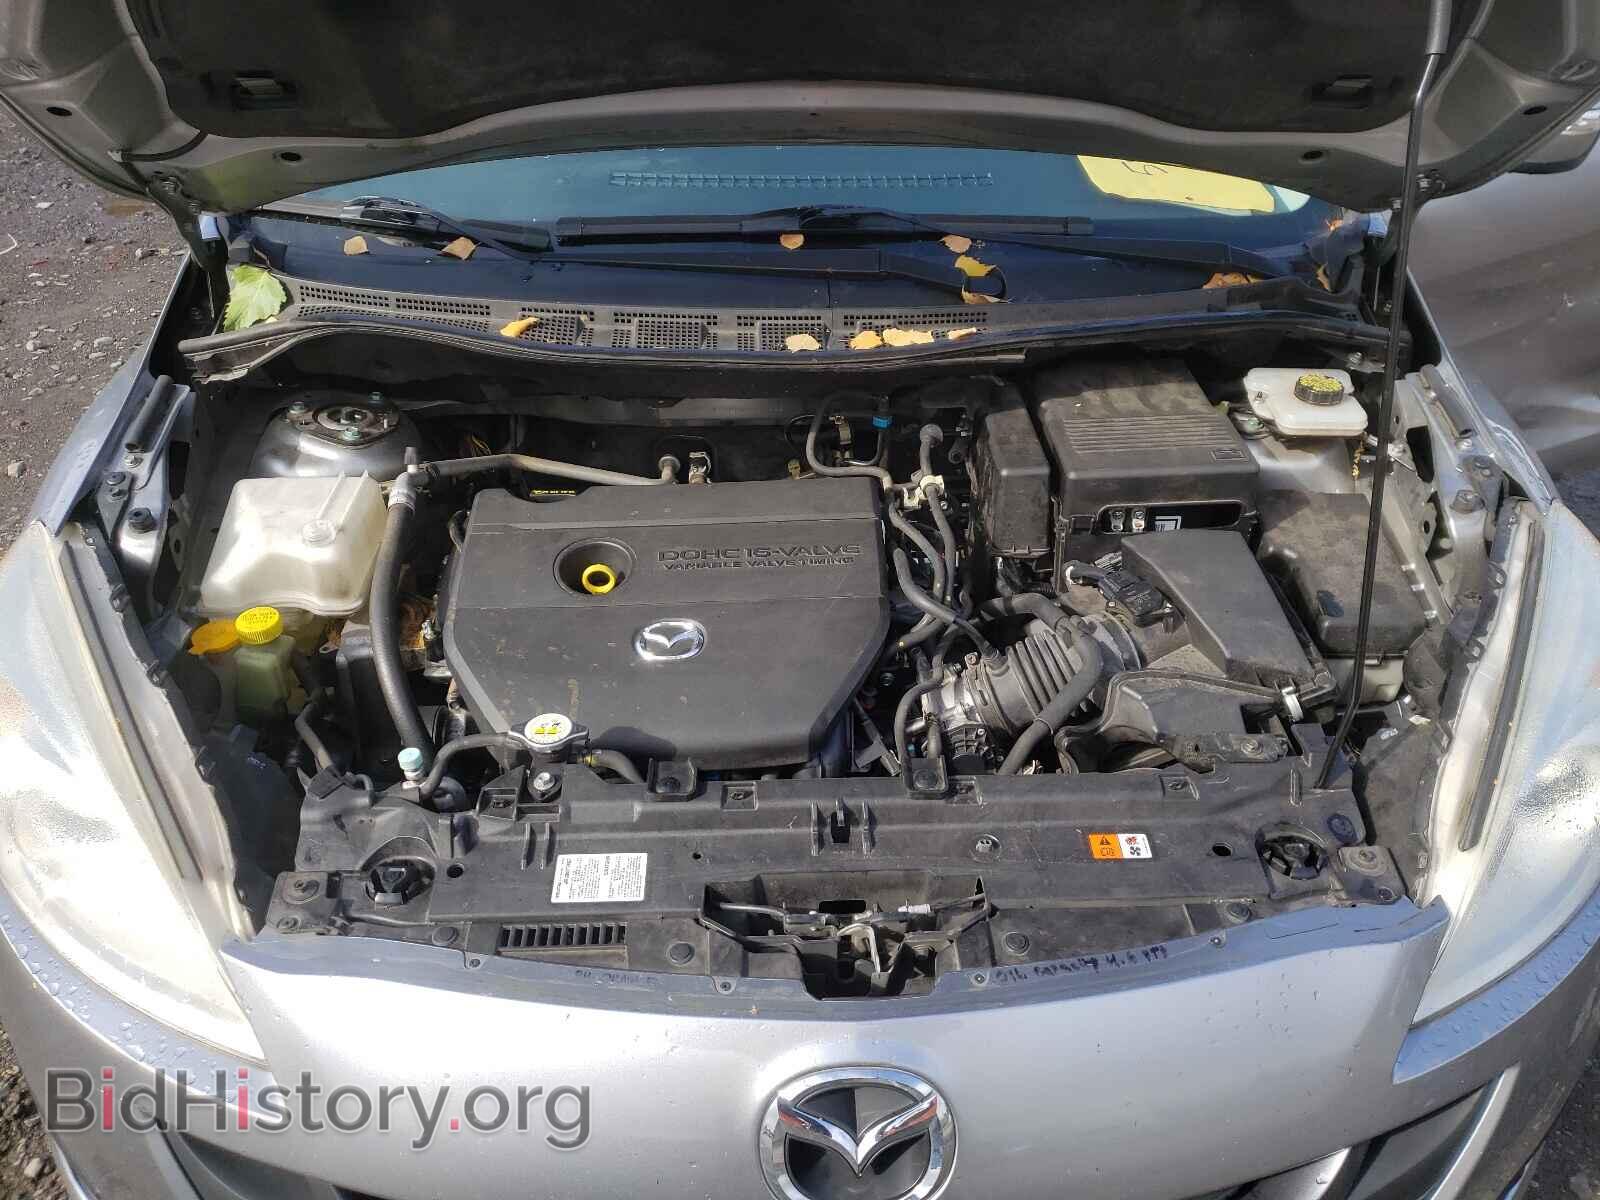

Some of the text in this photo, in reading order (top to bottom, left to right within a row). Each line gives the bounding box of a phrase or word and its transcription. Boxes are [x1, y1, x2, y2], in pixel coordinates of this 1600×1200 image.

[658, 547, 740, 562] DOHC
[663, 557, 855, 571] VARIABLE VALVE TIMING
